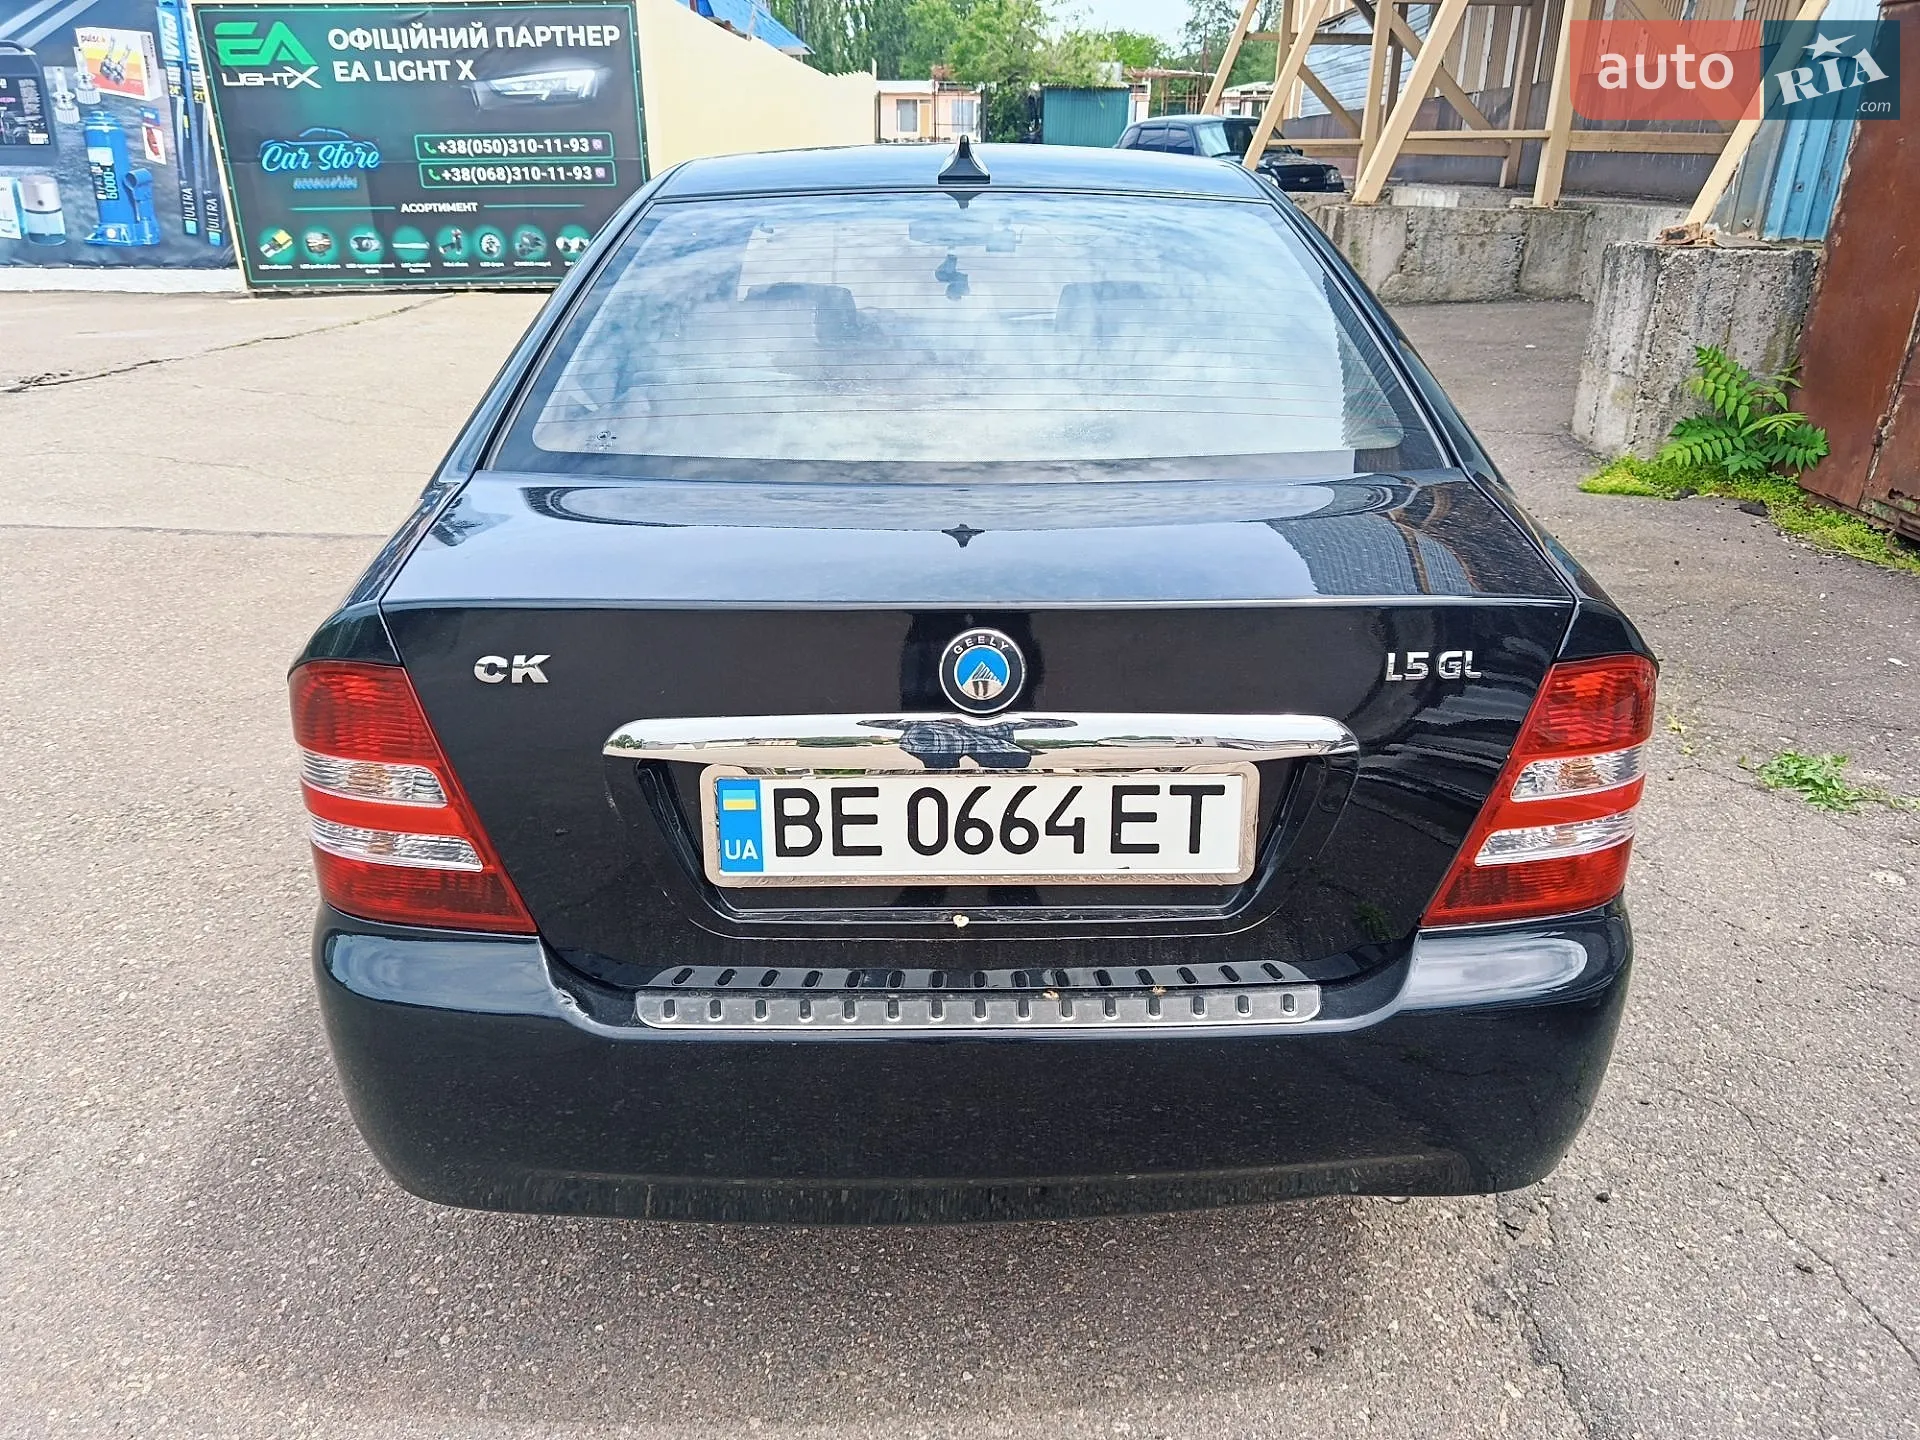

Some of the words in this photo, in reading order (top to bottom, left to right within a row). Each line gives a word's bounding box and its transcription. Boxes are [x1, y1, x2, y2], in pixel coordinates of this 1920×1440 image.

[214, 20, 318, 66] EA
[327, 22, 489, 53] ОФІЦІЙНИЙ
[495, 25, 621, 48] ПАРТНЕР
[332, 60, 371, 82] EA
[374, 59, 451, 82] LIGHT
[456, 59, 477, 81] X
[261, 145, 312, 172] Car
[318, 143, 380, 171] Store
[437, 137, 590, 157] +38(050)310-11-93
[441, 165, 593, 184] +38(068)310-11-93
[400, 202, 478, 213] АСОРТИМЕНТ
[953, 635, 1009, 655] GEELY
[474, 654, 552, 684] CK
[1435, 650, 1482, 679] GL
[774, 786, 883, 858] BE
[907, 785, 1086, 856] 0664
[1110, 784, 1226, 855] ET
[725, 841, 760, 861] UA
